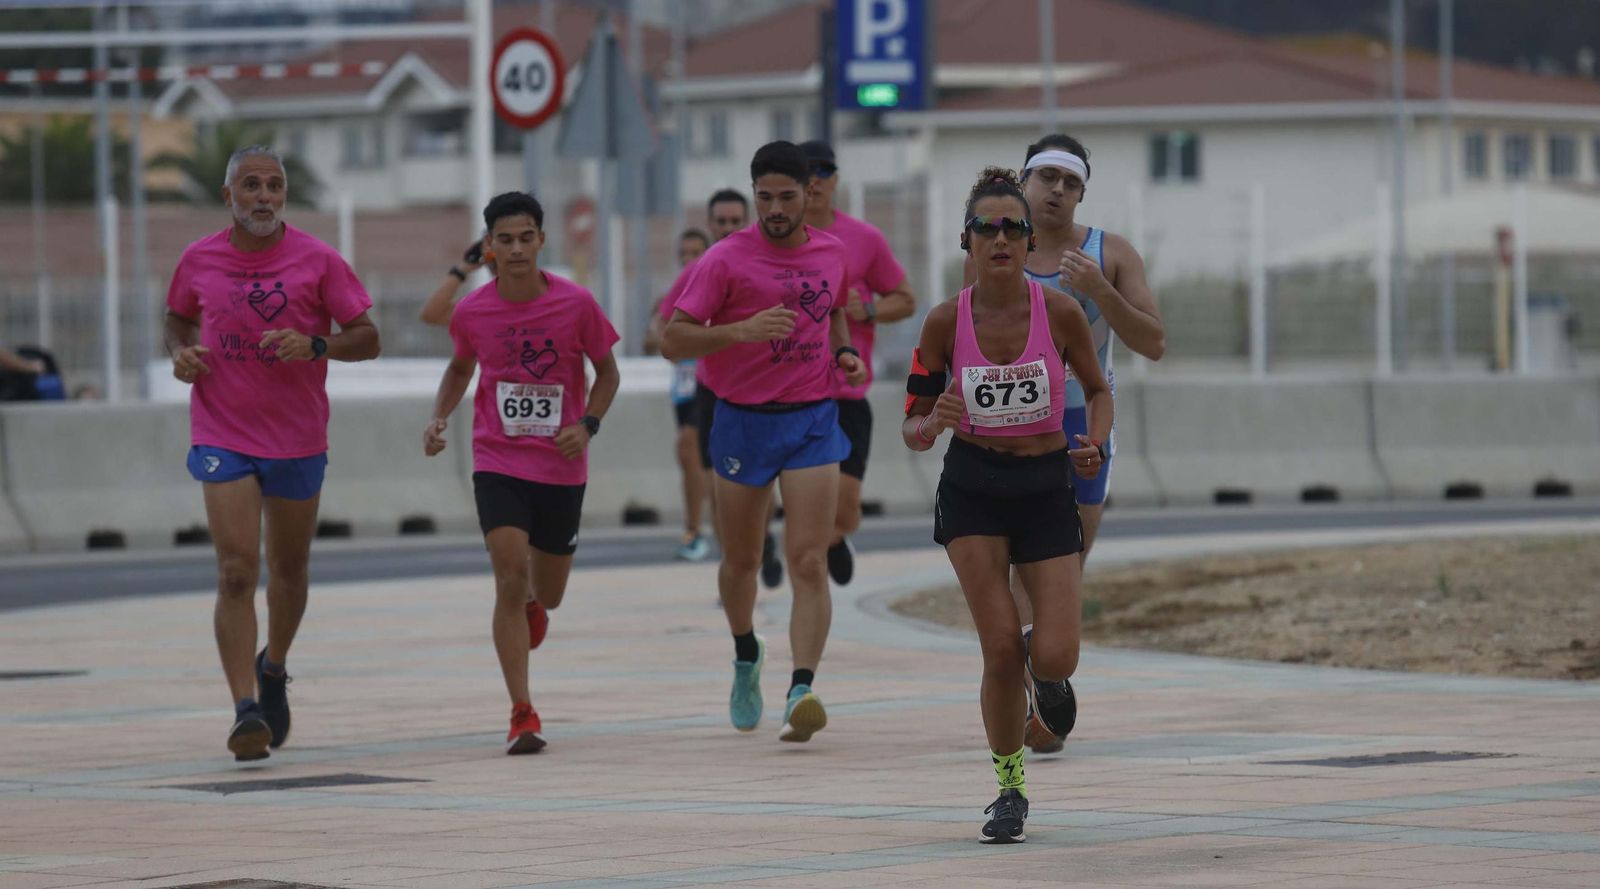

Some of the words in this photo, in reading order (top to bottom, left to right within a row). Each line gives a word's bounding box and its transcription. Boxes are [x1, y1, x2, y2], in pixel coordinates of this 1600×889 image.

[503, 61, 546, 93] 40
[983, 375, 1000, 383] POR
[1003, 374, 1014, 382] LA
[1016, 369, 1045, 380] MUJER
[1003, 363, 1040, 375] CARRERA
[974, 380, 1039, 409] 673
[503, 397, 551, 418] 693
